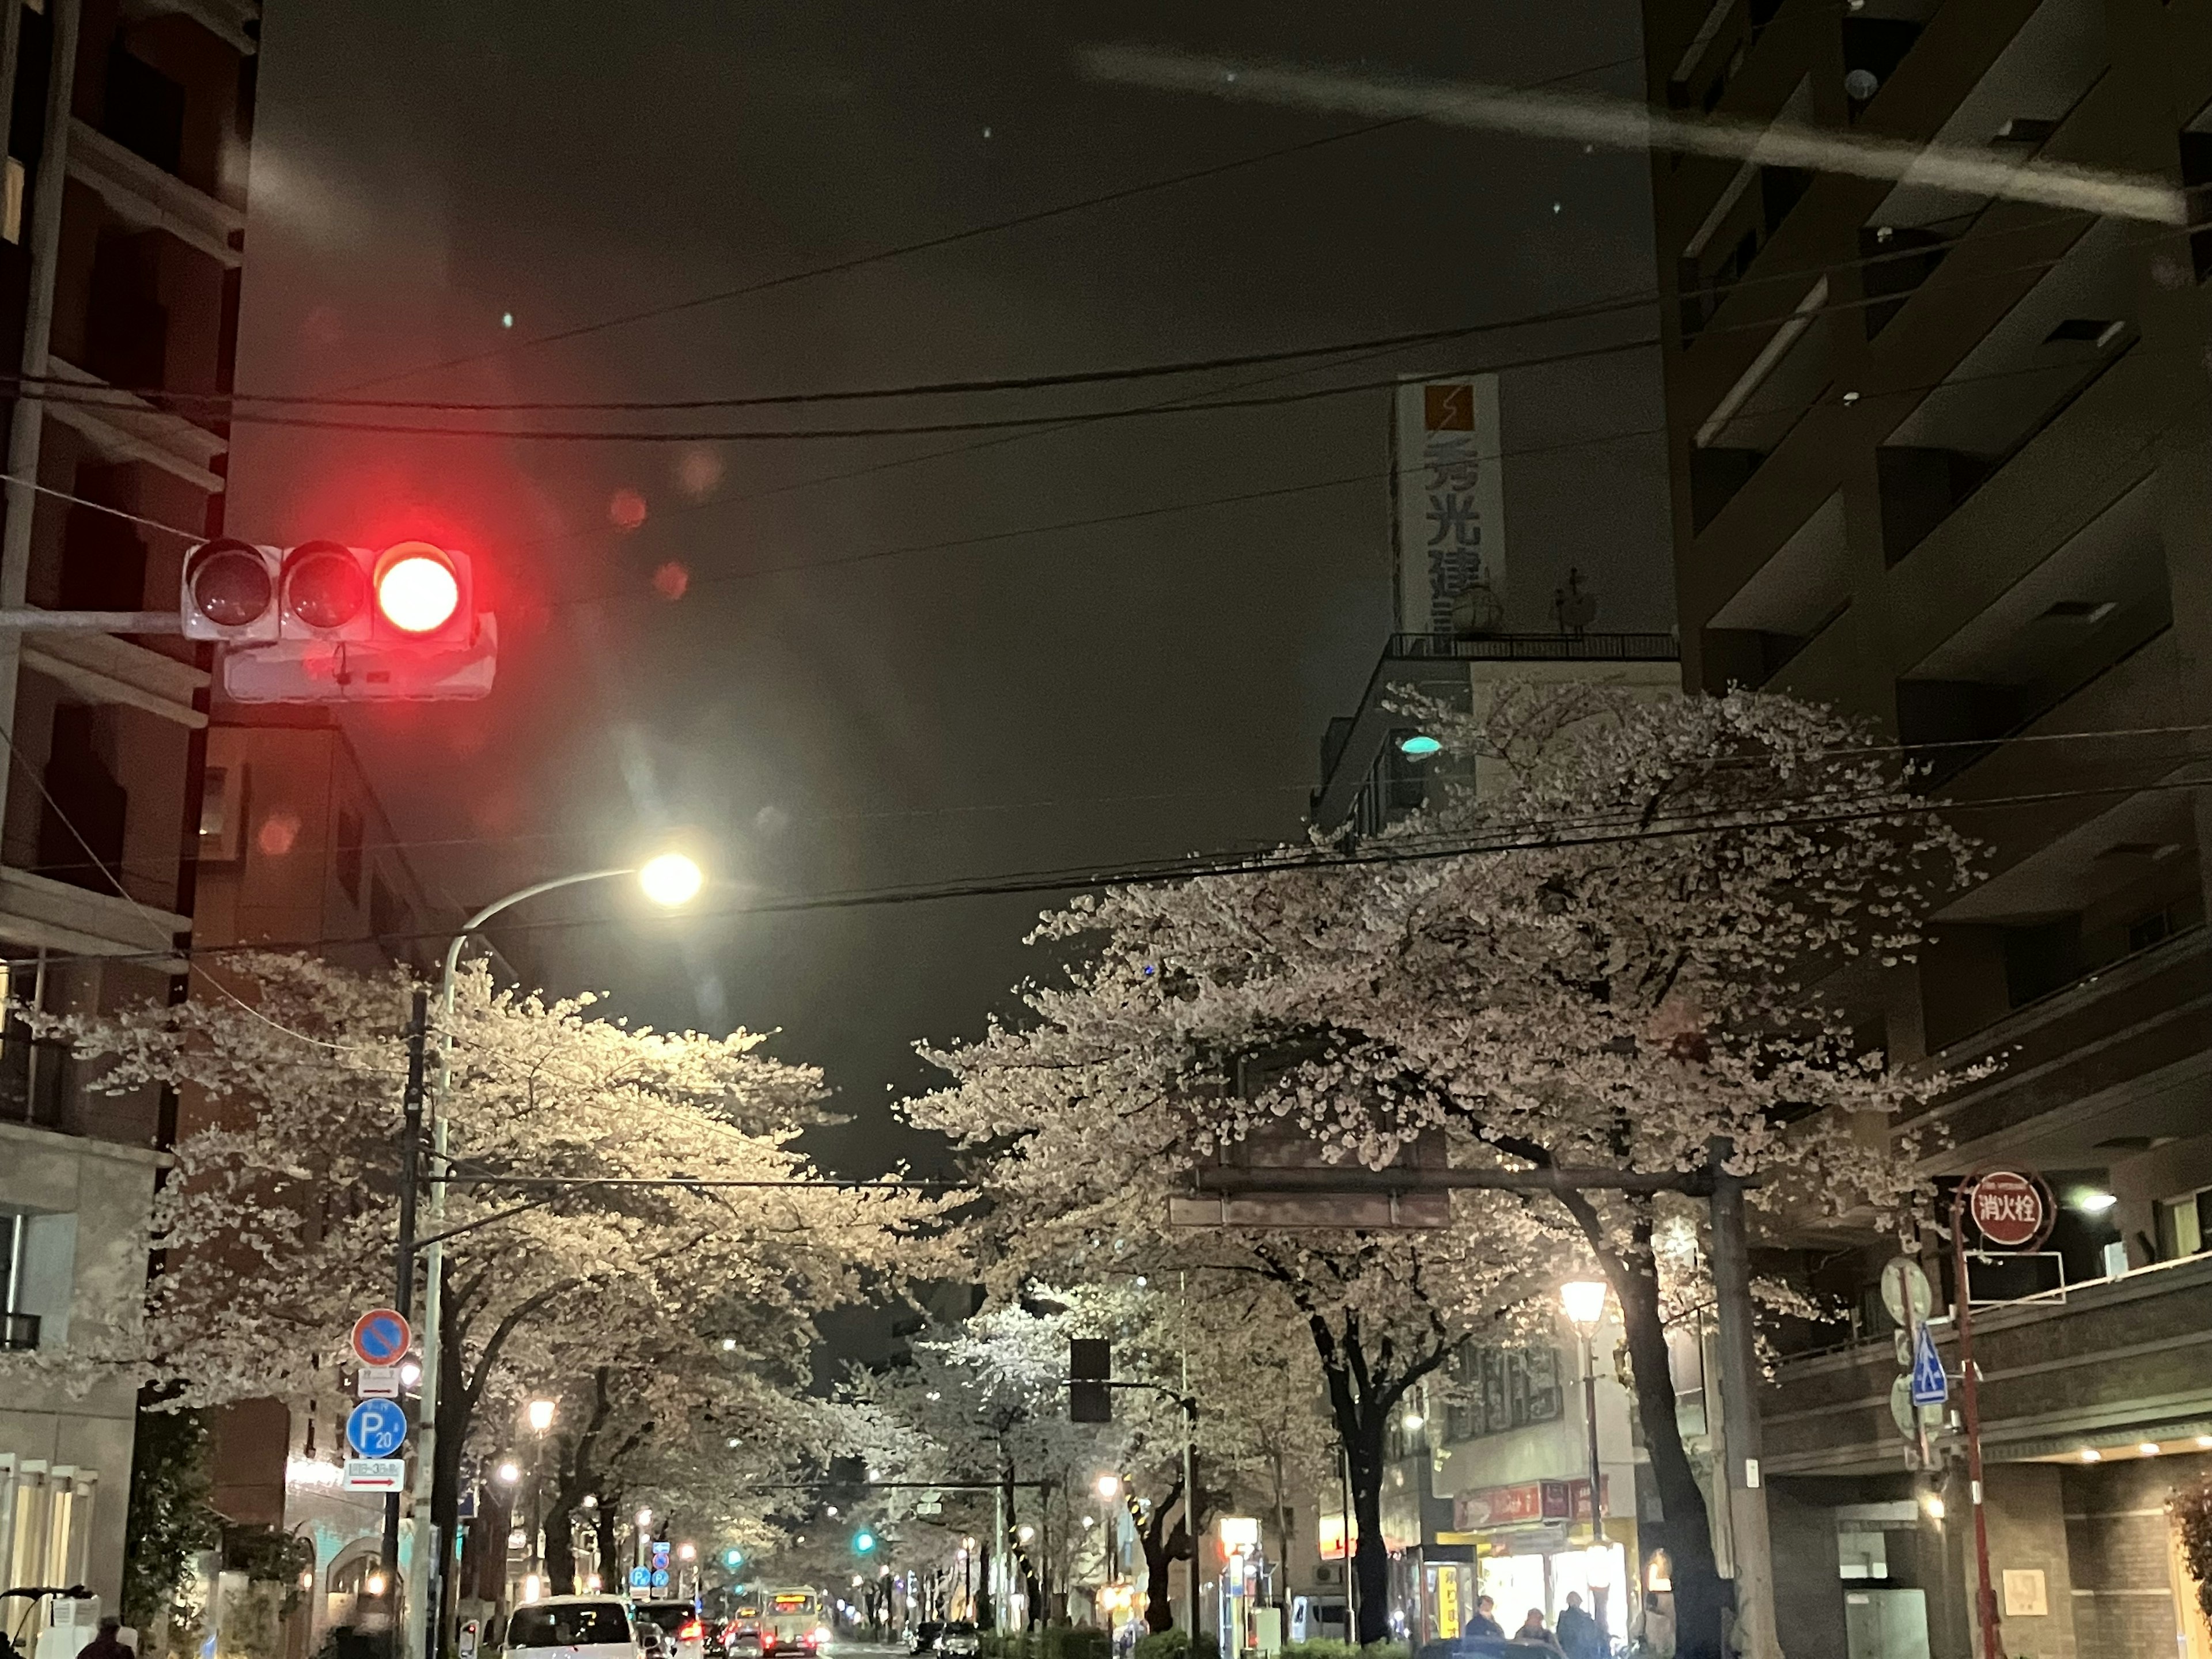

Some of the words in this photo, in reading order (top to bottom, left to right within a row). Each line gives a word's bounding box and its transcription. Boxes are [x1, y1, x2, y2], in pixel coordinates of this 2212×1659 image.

[1978, 1194, 2036, 1222] 消火栓
[360, 1412, 383, 1449] P
[376, 1432, 392, 1449] 20
